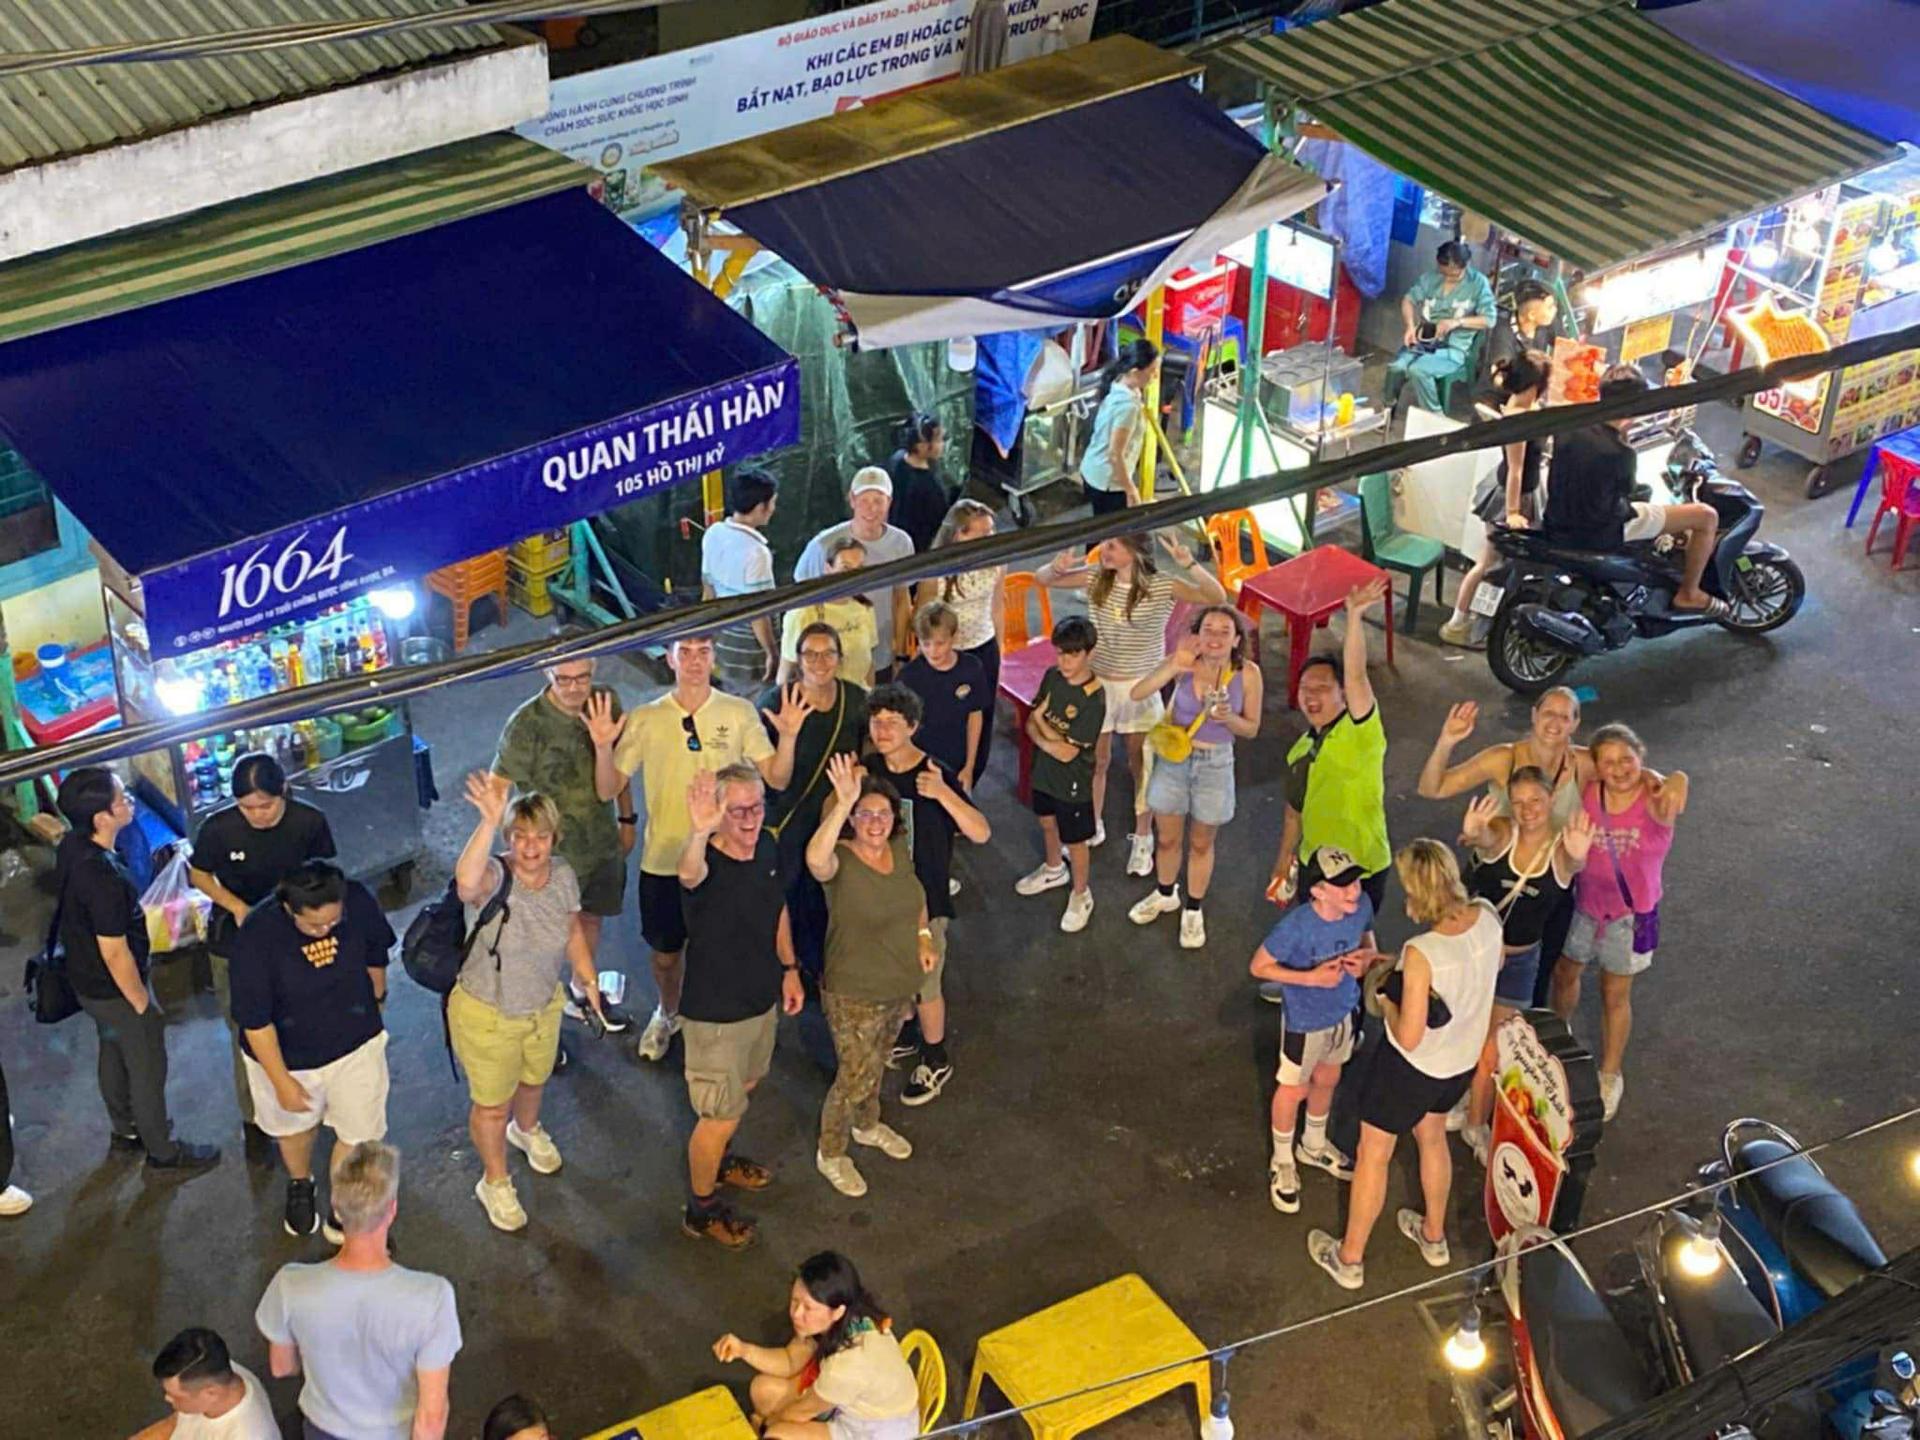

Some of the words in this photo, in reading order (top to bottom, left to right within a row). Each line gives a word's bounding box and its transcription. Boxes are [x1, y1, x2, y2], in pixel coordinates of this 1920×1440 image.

[806, 52, 833, 72] KHI
[836, 41, 868, 64] CÁC
[869, 37, 893, 56] EM
[881, 47, 931, 74] TRONG
[542, 431, 636, 493] QUAN
[643, 401, 714, 455] THÁI
[722, 381, 785, 431] HÀN
[615, 473, 644, 497] 105
[646, 460, 672, 487] HỒ
[675, 454, 703, 479] THỊ
[218, 525, 354, 618] 1664
